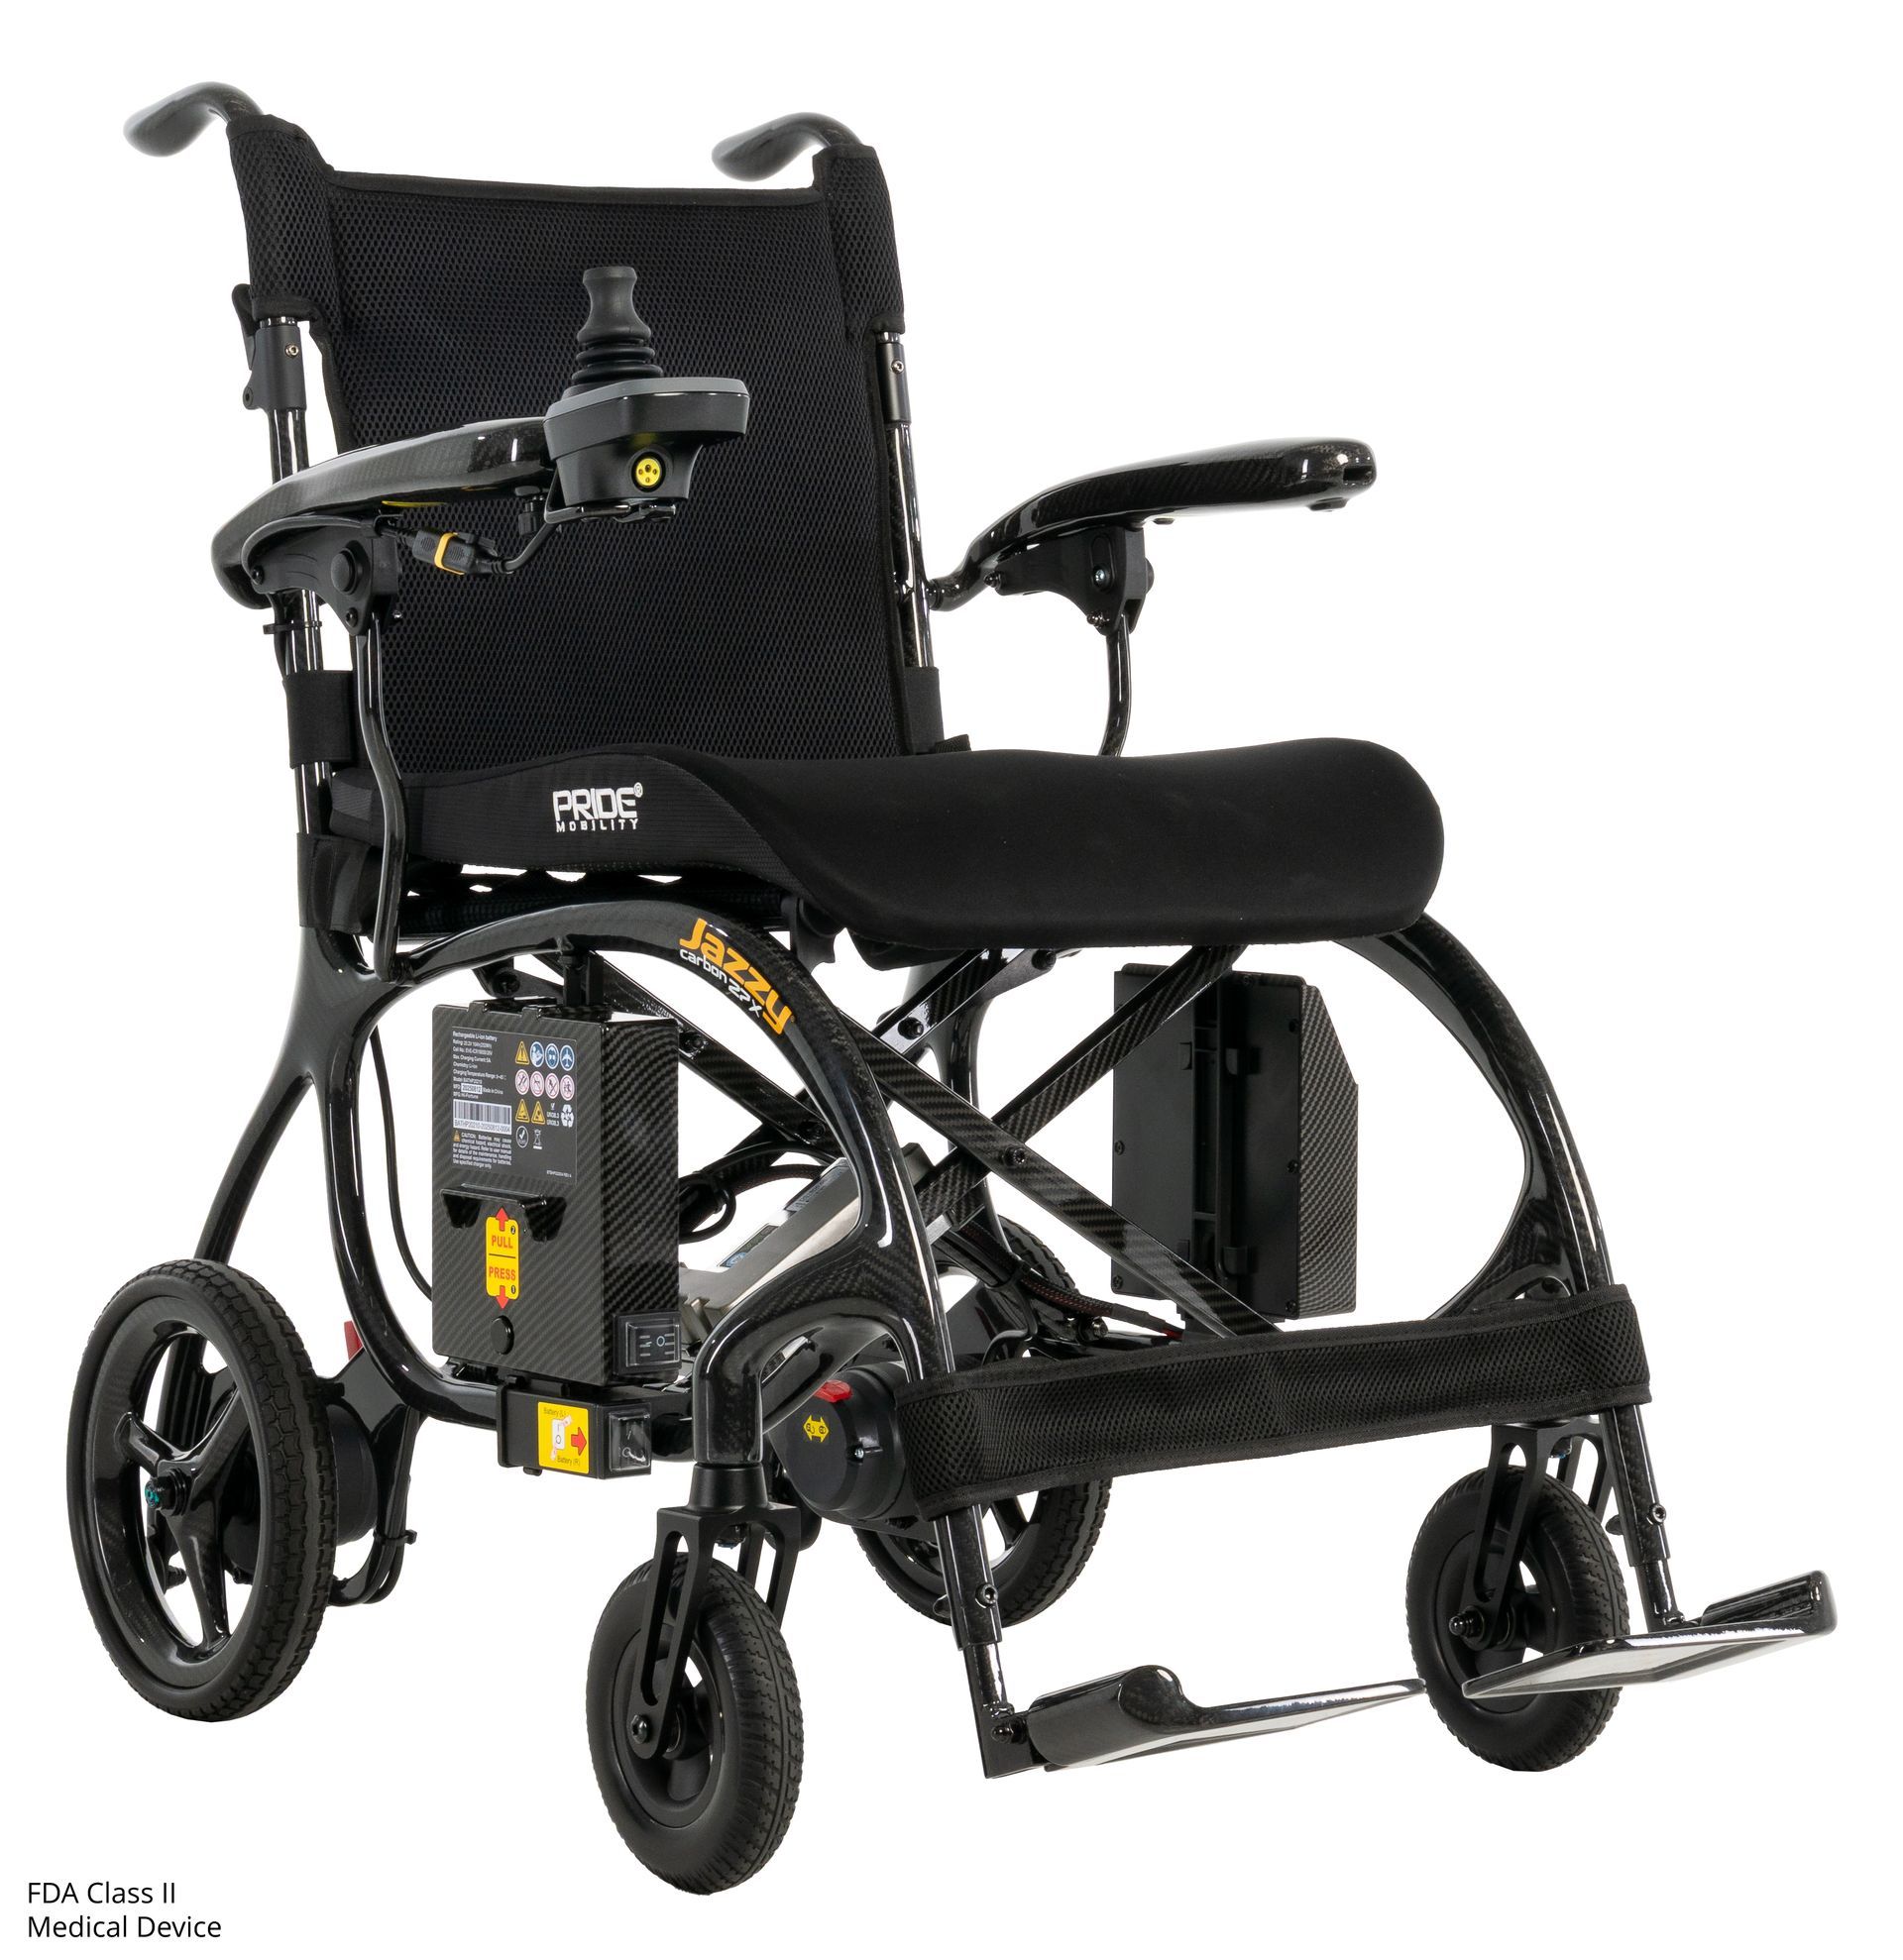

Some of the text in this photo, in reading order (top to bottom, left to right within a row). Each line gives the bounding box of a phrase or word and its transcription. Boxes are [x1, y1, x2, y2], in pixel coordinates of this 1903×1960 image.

[556, 818, 639, 832] MOBILITY
[679, 948, 728, 984] carbon
[748, 999, 762, 1019] X
[492, 1235, 513, 1249] PULL
[489, 1266, 516, 1281] PRESS
